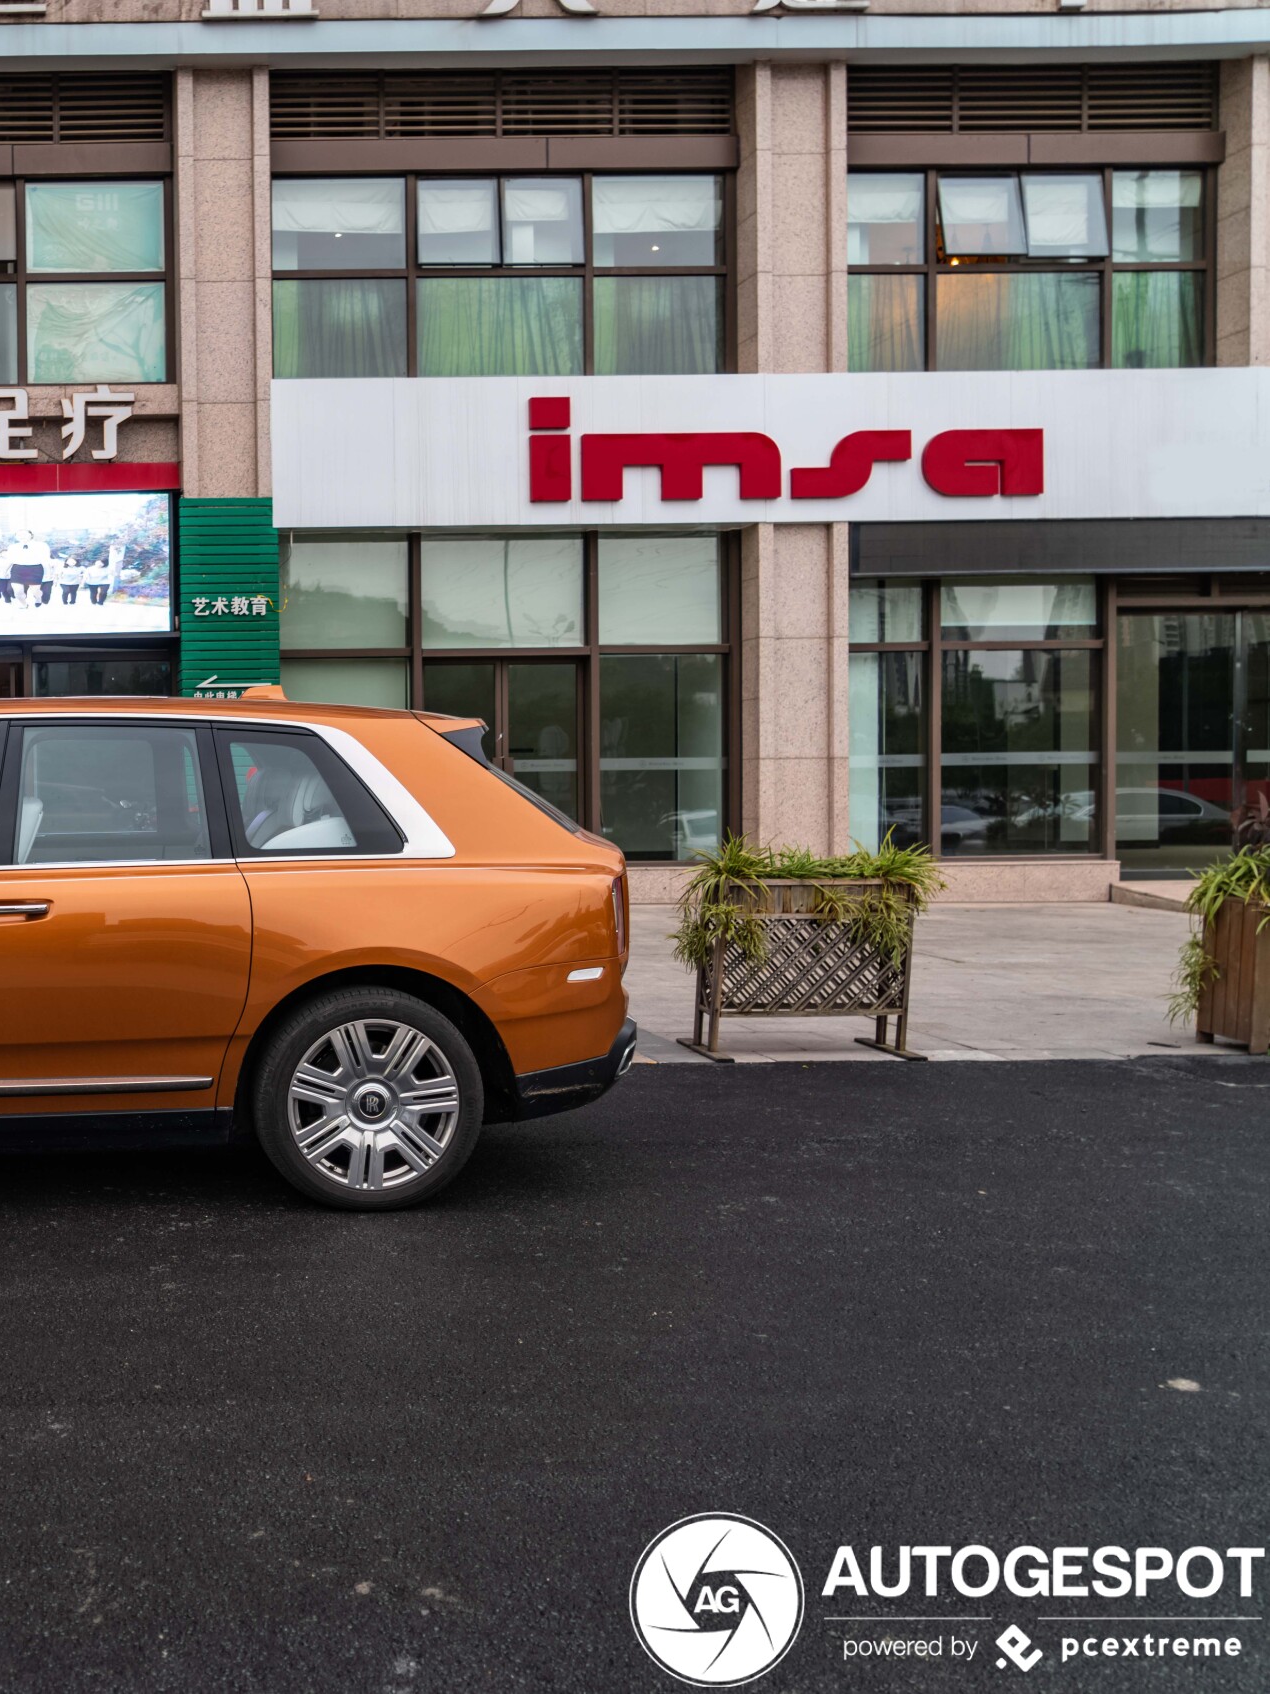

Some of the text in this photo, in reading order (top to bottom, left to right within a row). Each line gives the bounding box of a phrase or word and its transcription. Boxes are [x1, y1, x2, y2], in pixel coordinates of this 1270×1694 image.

[529, 396, 1044, 502] imsa
[191, 595, 268, 617] 艺术教育
